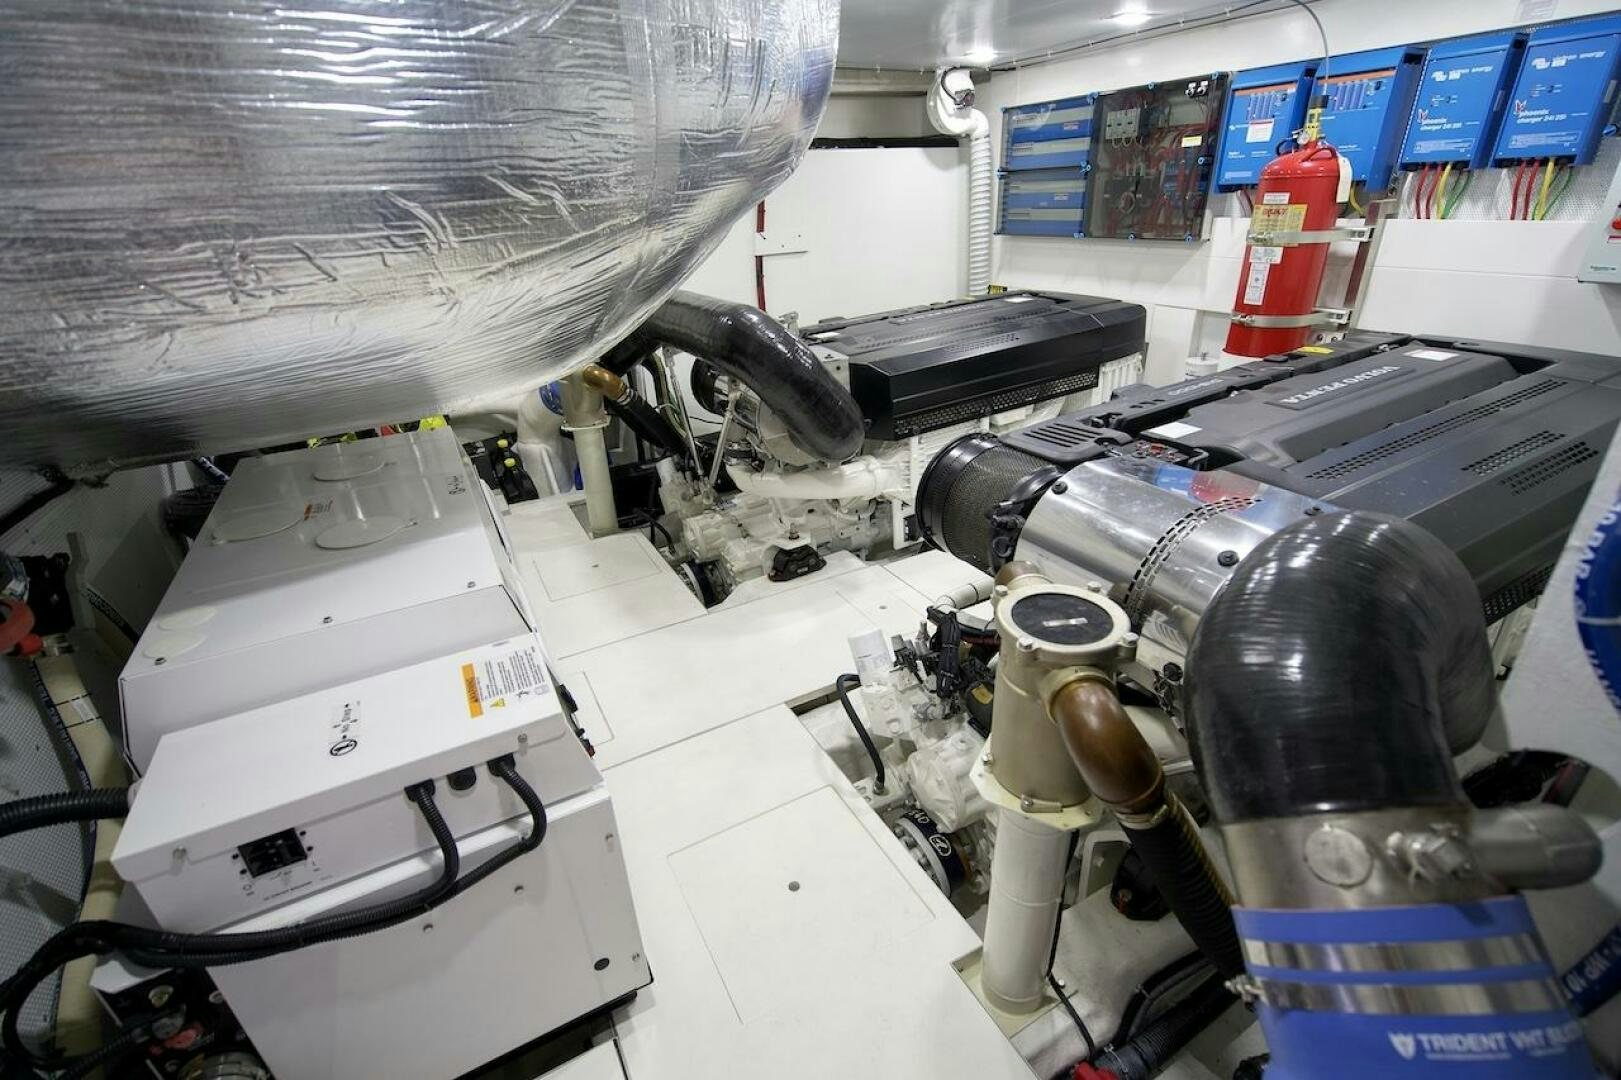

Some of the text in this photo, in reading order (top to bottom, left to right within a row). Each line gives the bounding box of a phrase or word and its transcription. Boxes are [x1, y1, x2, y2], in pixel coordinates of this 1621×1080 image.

[1280, 366, 1401, 404] VOLVO PENTA
[1416, 1031, 1509, 1052] TRIDENT
